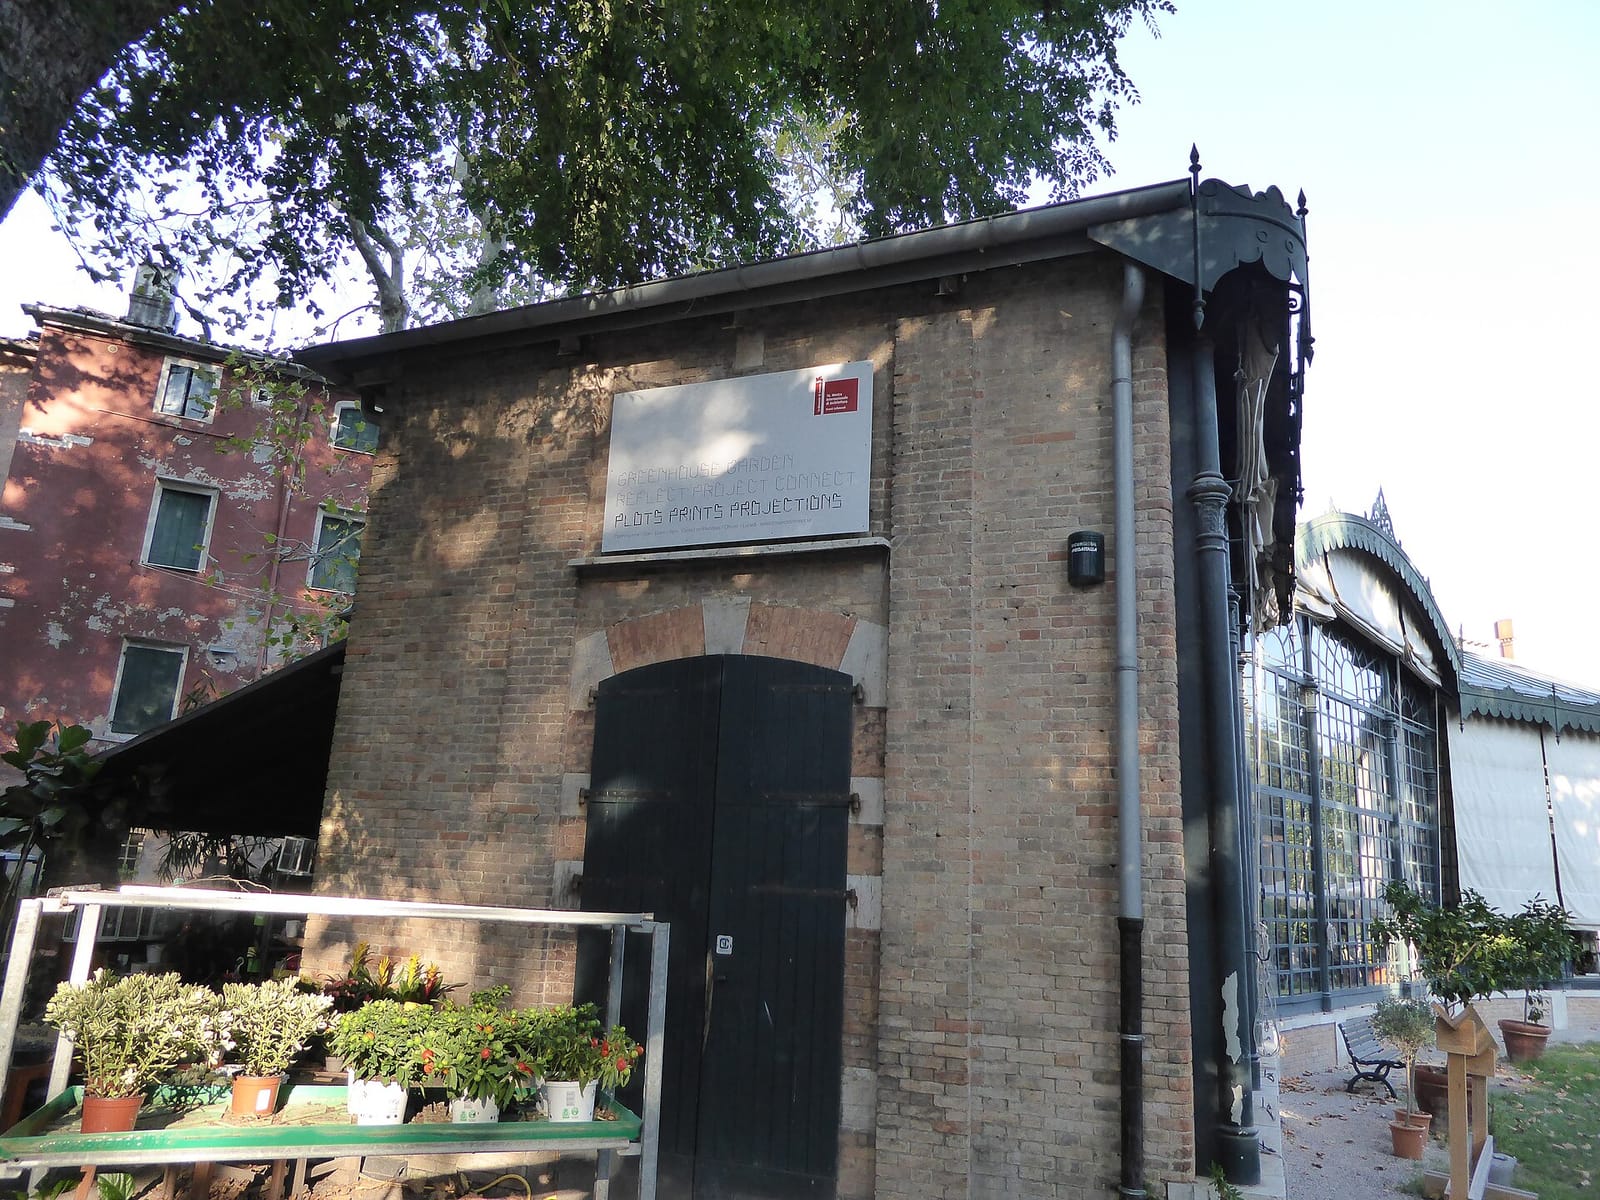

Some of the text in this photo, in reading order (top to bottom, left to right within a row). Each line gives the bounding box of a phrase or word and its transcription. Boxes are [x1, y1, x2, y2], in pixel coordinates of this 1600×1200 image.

[617, 454, 794, 486] GREENHOUSE GARDEN
[616, 470, 856, 507] REFLECT PROJECT CONNECT
[614, 492, 843, 528] PLOTS PRINTS PROJECTIONS
